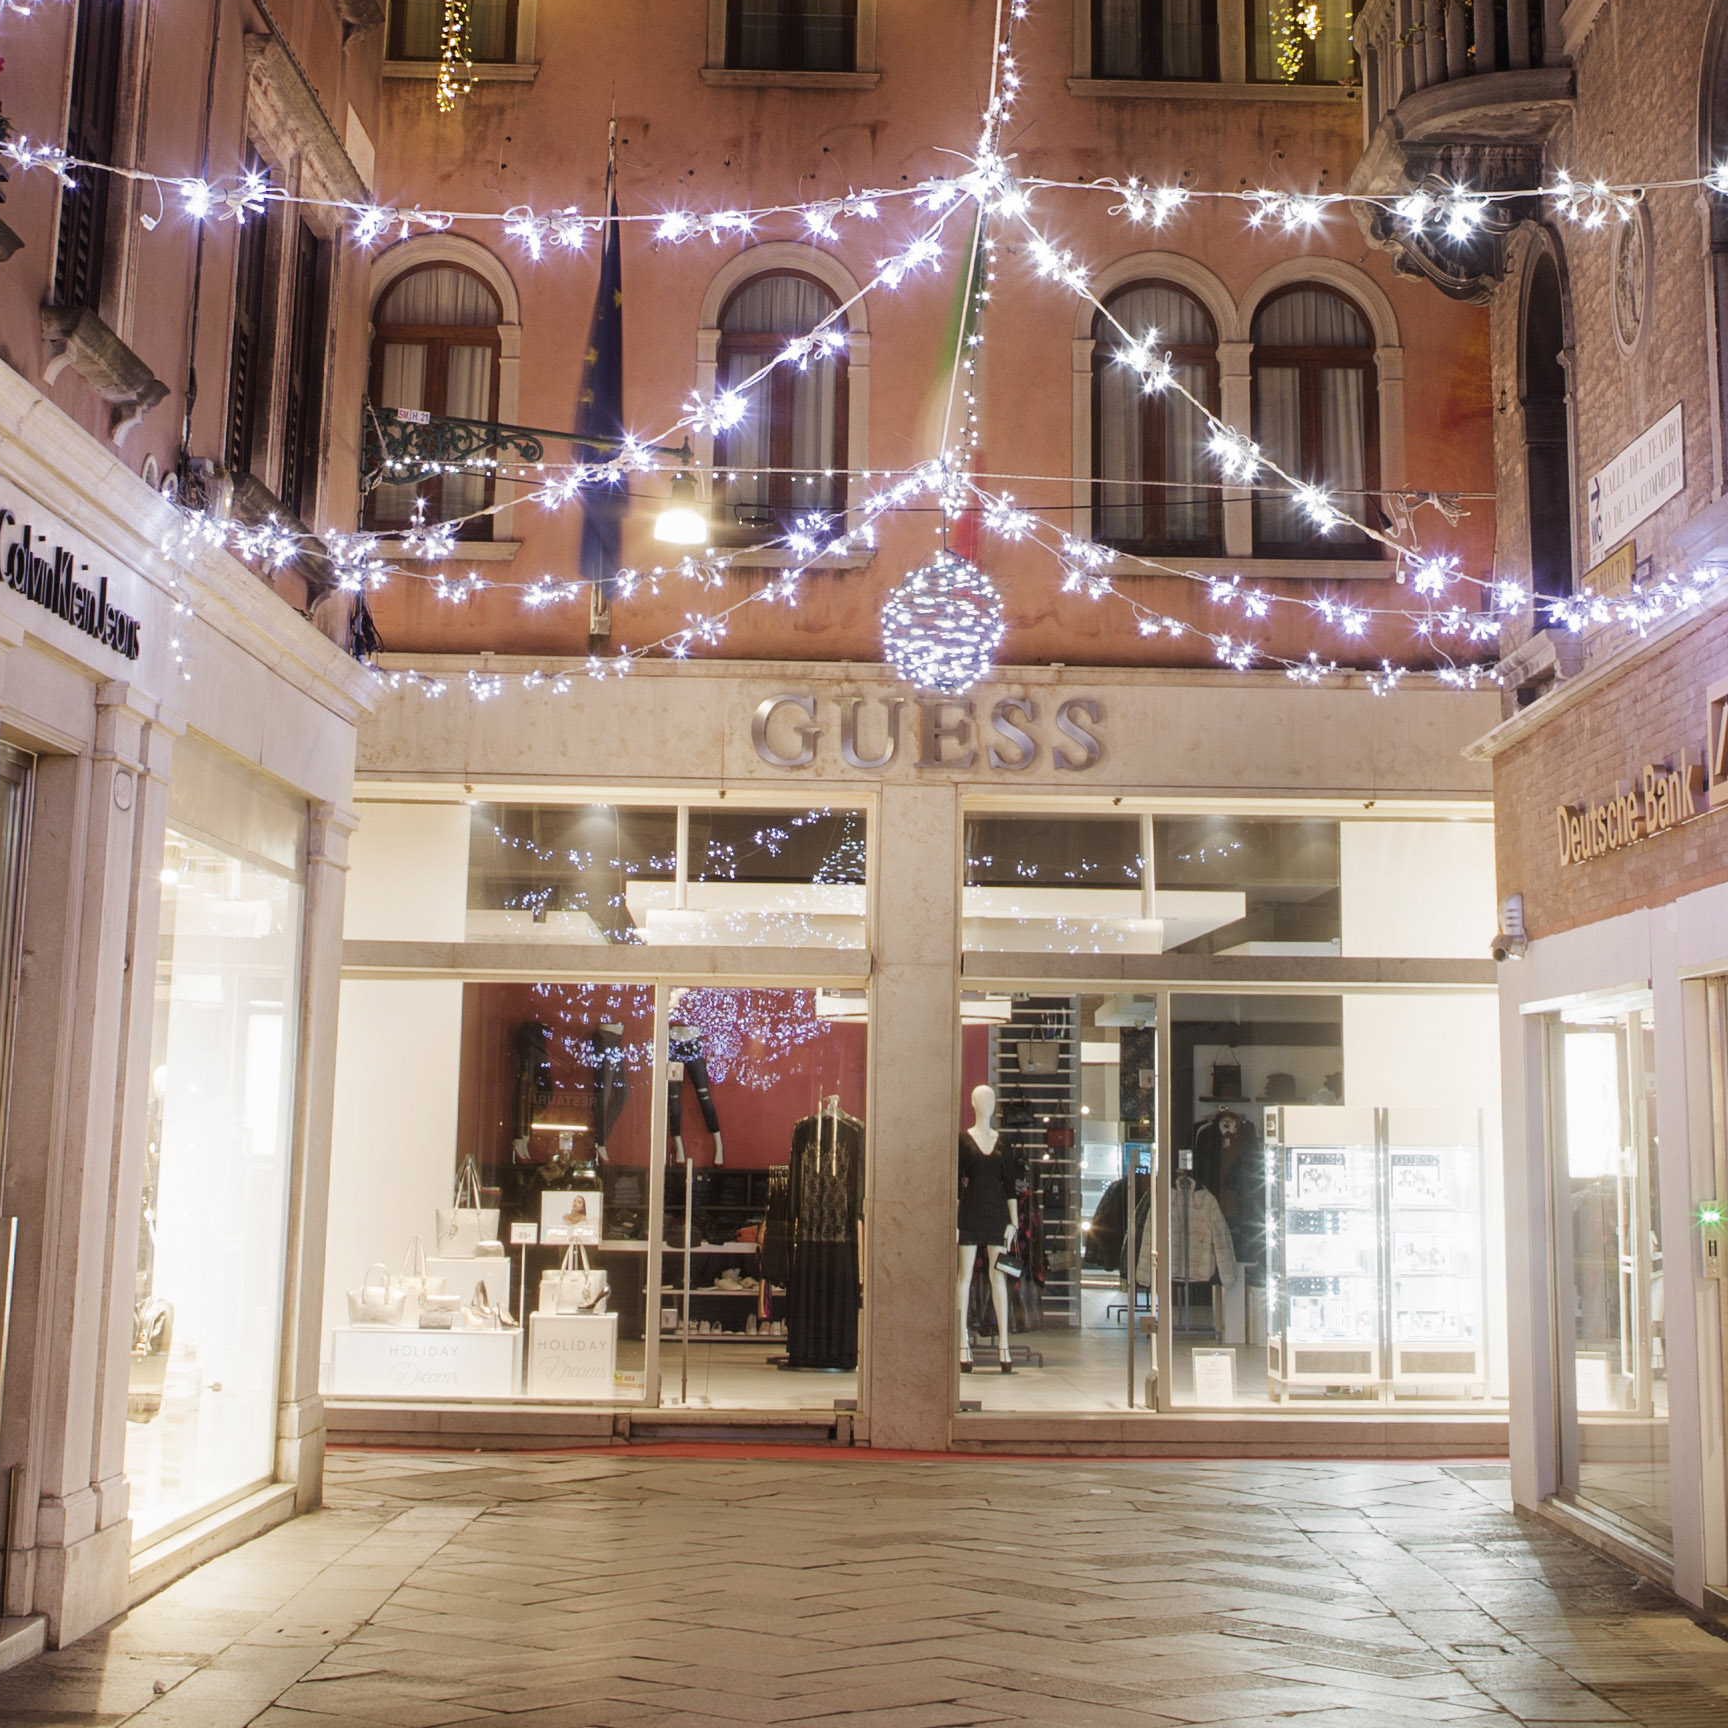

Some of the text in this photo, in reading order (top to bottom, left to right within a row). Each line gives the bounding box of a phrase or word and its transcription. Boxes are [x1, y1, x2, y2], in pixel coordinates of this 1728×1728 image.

[1602, 417, 1680, 499] CALLE DEL TEATRO
[1613, 502, 1625, 529] DE
[1627, 493, 1639, 518] LA
[1640, 455, 1682, 507] COMMEDIA
[1590, 514, 1603, 547] WC
[751, 693, 1103, 772] GUESS
[1556, 746, 1698, 867] Deutsche Bank
[389, 1344, 460, 1357] HOLIDAY
[538, 1338, 608, 1352] HOLIDAY
[389, 1361, 458, 1387] Dreams
[538, 1355, 607, 1381] Dreams
